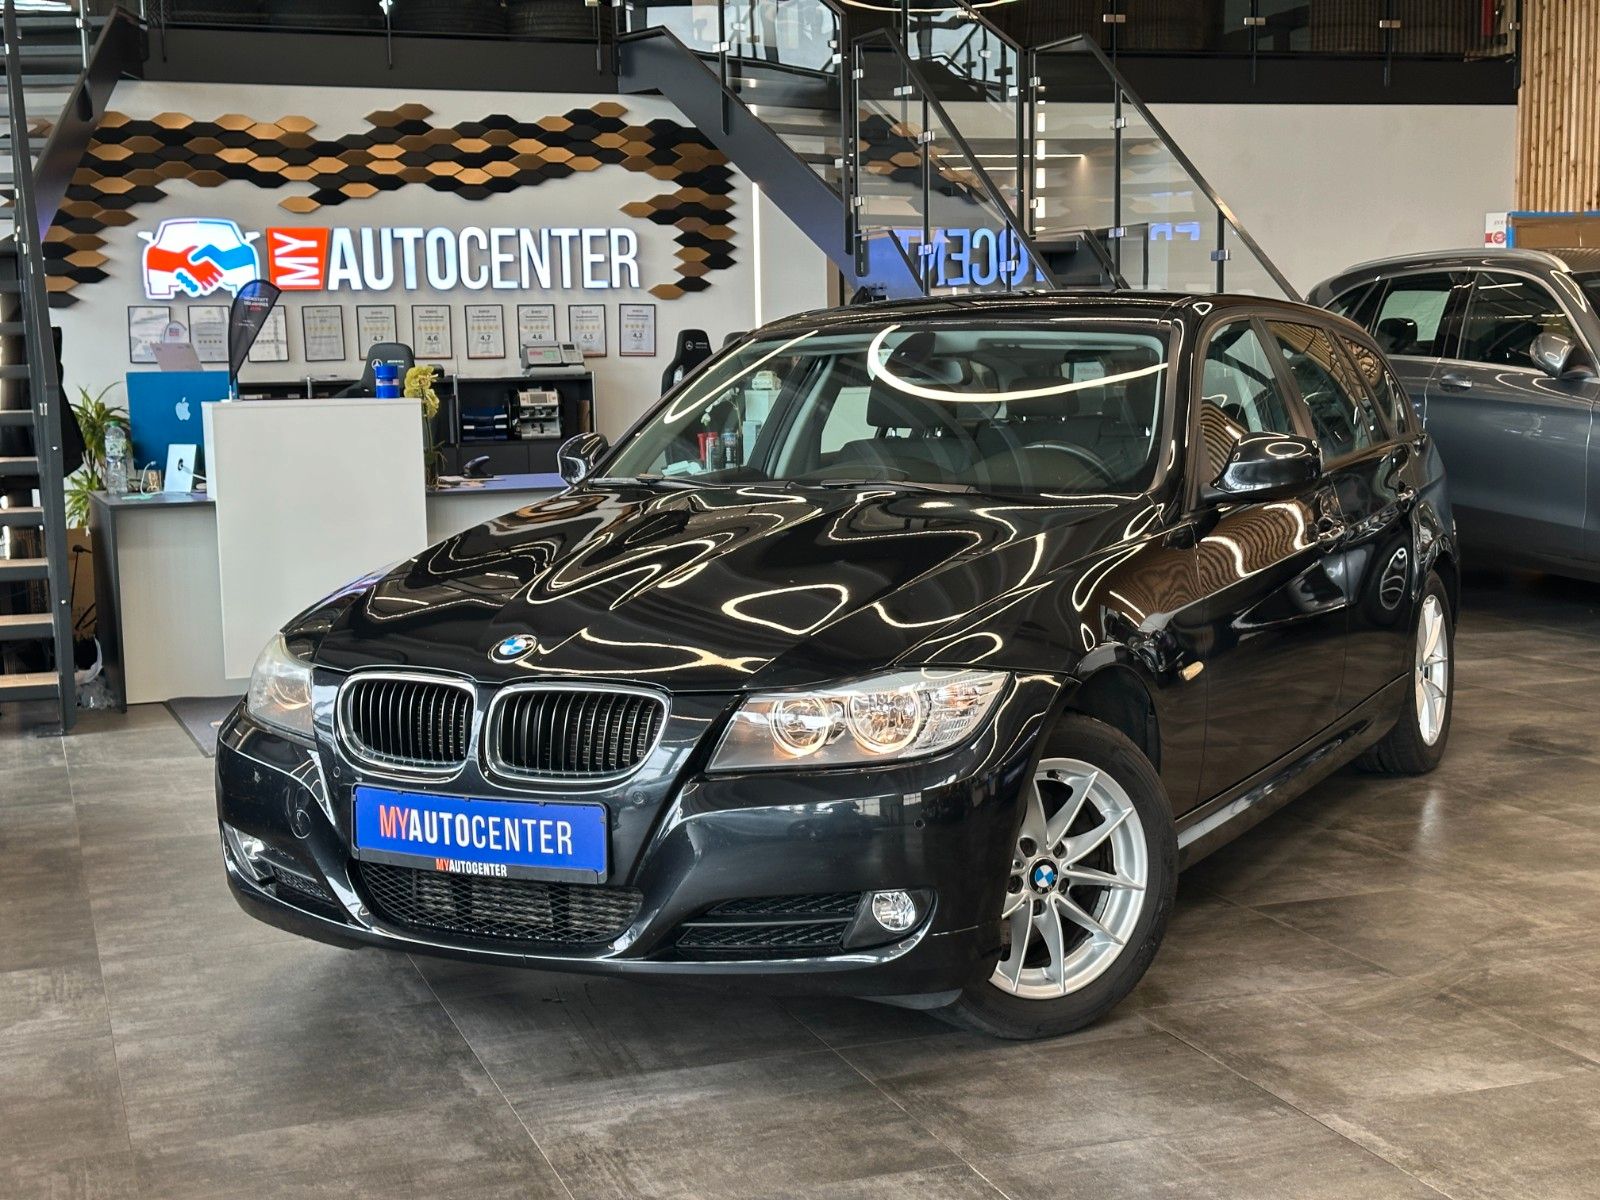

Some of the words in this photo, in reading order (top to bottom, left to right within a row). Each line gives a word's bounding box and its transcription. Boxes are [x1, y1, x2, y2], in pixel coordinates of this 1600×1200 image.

[273, 232, 320, 286] MY
[327, 227, 641, 291] AUTOCENTER
[378, 804, 573, 855] MYAUTOCENTER
[435, 858, 508, 878] MYAUTOCENTER
